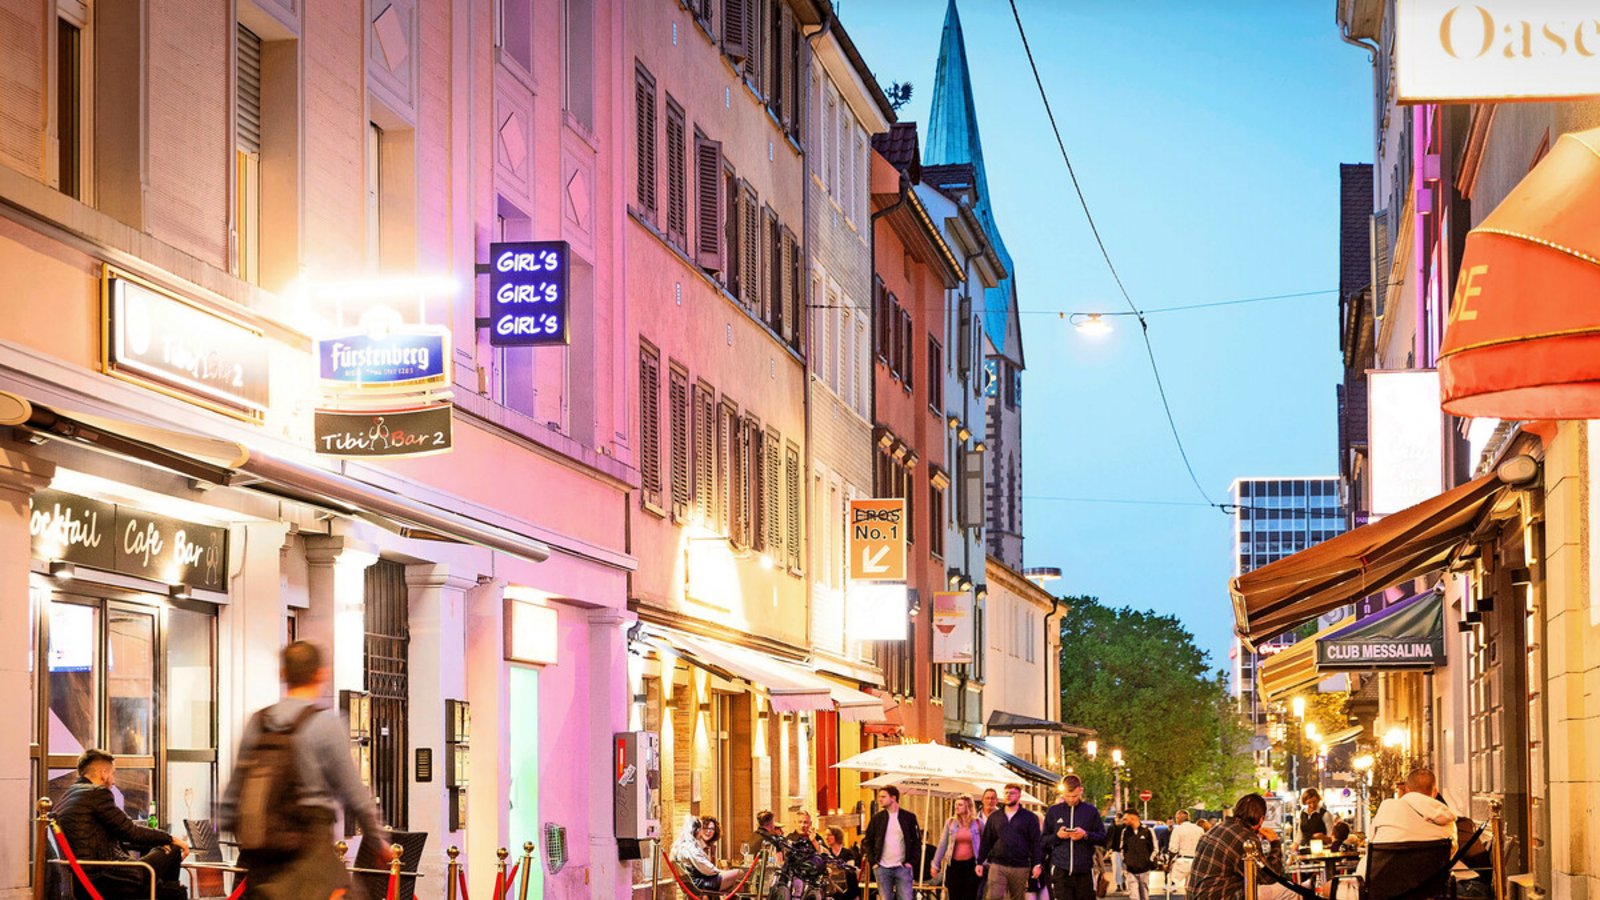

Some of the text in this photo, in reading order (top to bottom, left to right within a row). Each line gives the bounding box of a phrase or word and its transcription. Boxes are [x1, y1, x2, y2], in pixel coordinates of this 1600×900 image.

[496, 250, 558, 272] GIRL'S
[496, 282, 558, 303] GIRL'S
[496, 313, 558, 335] GIRL'S
[330, 342, 430, 372] Fürstenberg
[321, 430, 446, 450] Tibi Bar 2
[29, 497, 101, 548] ocktail
[174, 530, 203, 567] Bar
[1327, 643, 1433, 659] CLUB MESSALINA
